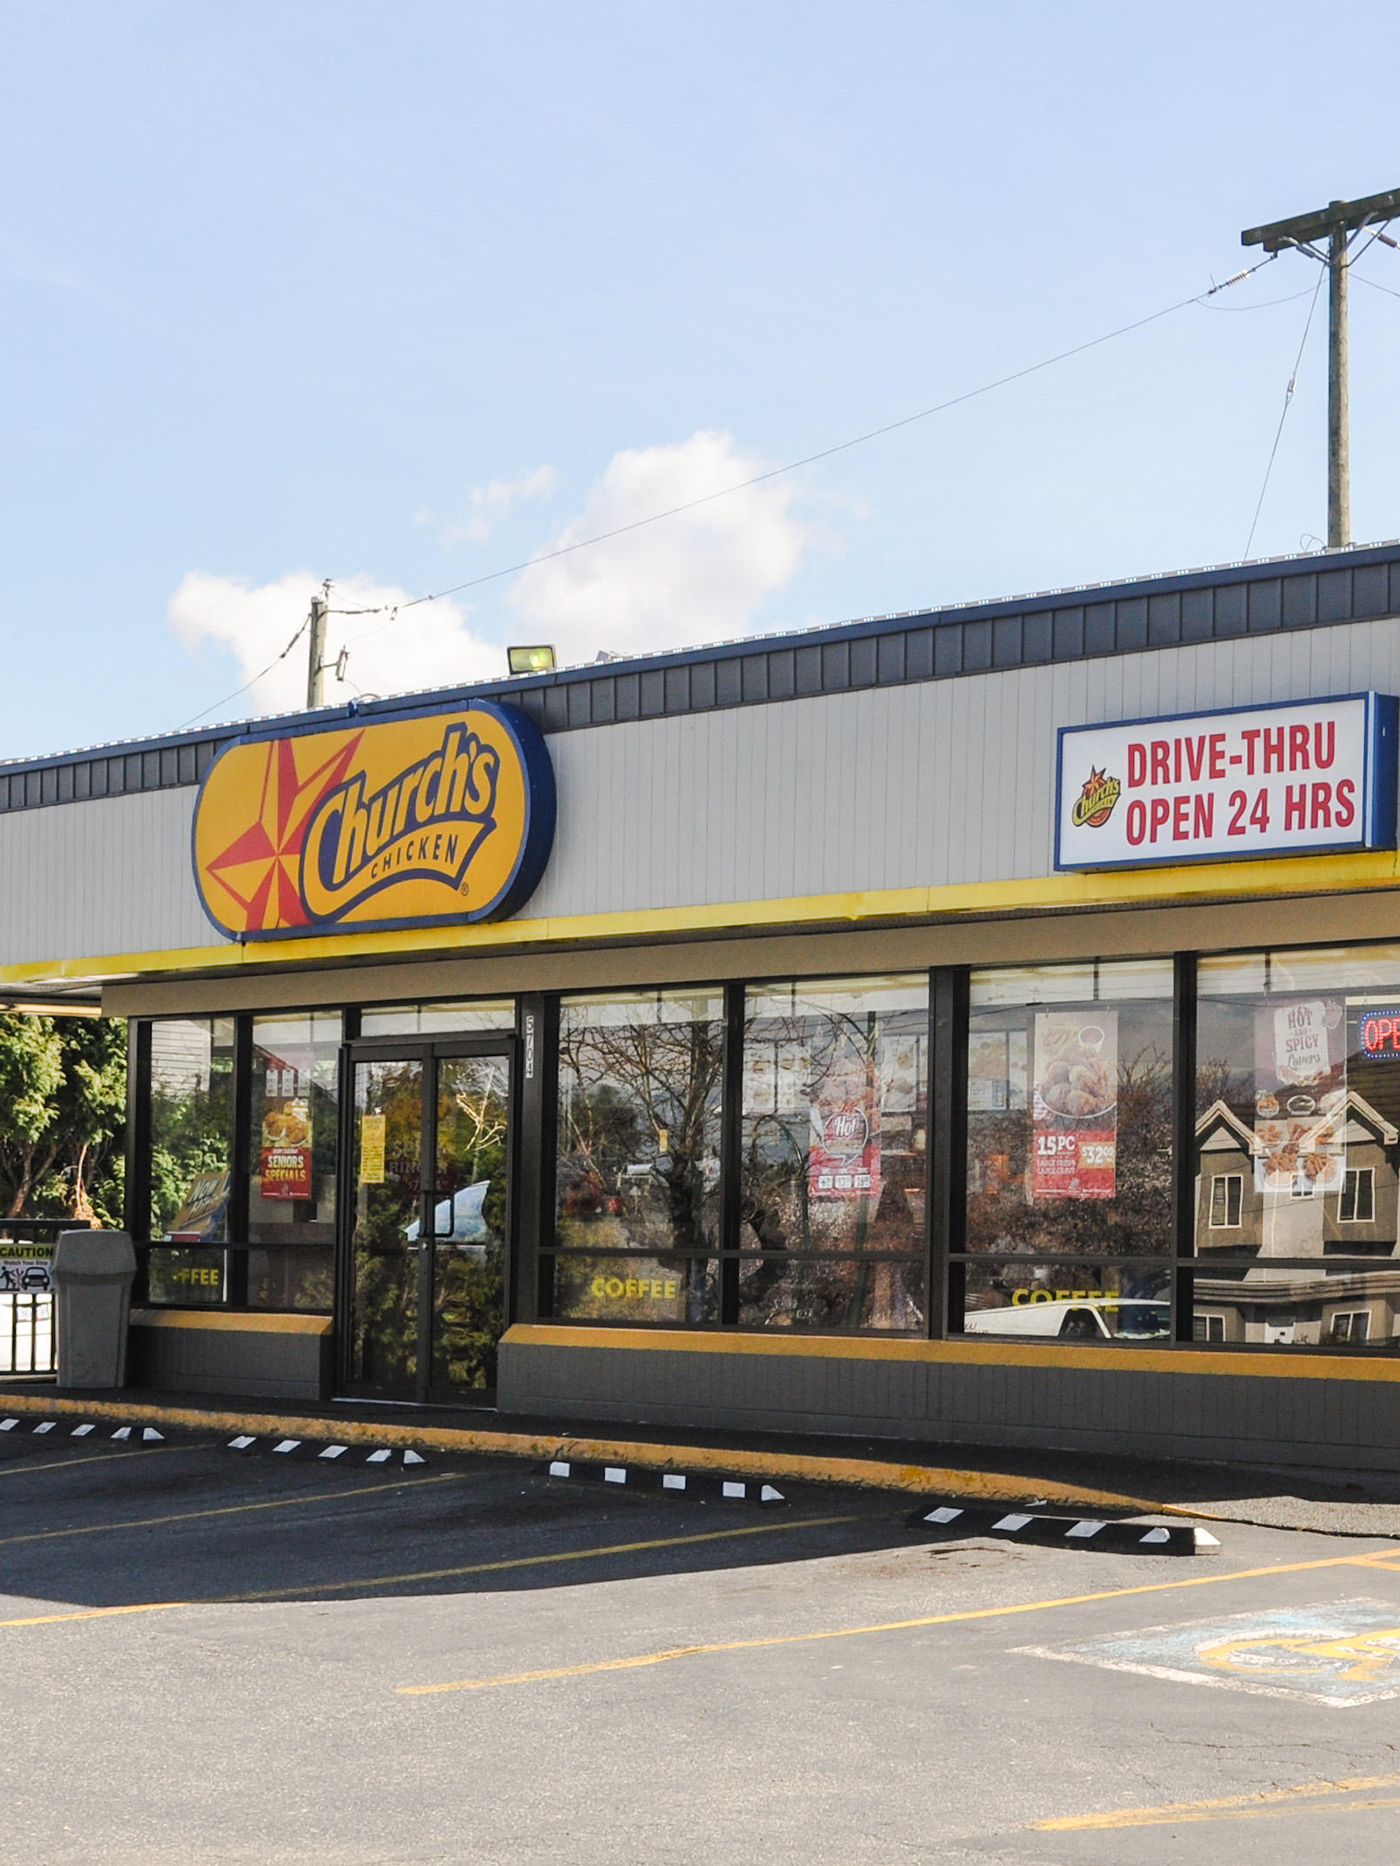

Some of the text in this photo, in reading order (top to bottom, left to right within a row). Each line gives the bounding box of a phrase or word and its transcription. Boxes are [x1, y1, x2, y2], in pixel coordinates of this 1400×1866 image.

[1127, 721, 1335, 788] DRIVE-THRU
[303, 730, 496, 916] Church's
[1126, 779, 1355, 846] OPEN 24 HRS
[371, 834, 458, 880] CHICKEN
[1288, 1006, 1313, 1029] HOT
[1286, 1034, 1318, 1052] SPICY
[267, 1155, 304, 1168] SENIORS
[265, 1169, 307, 1182] SPECIALS
[0, 1247, 53, 1257] CAUTION
[591, 1277, 676, 1299] COFFEE
[1012, 1288, 1119, 1312] COFFEE
